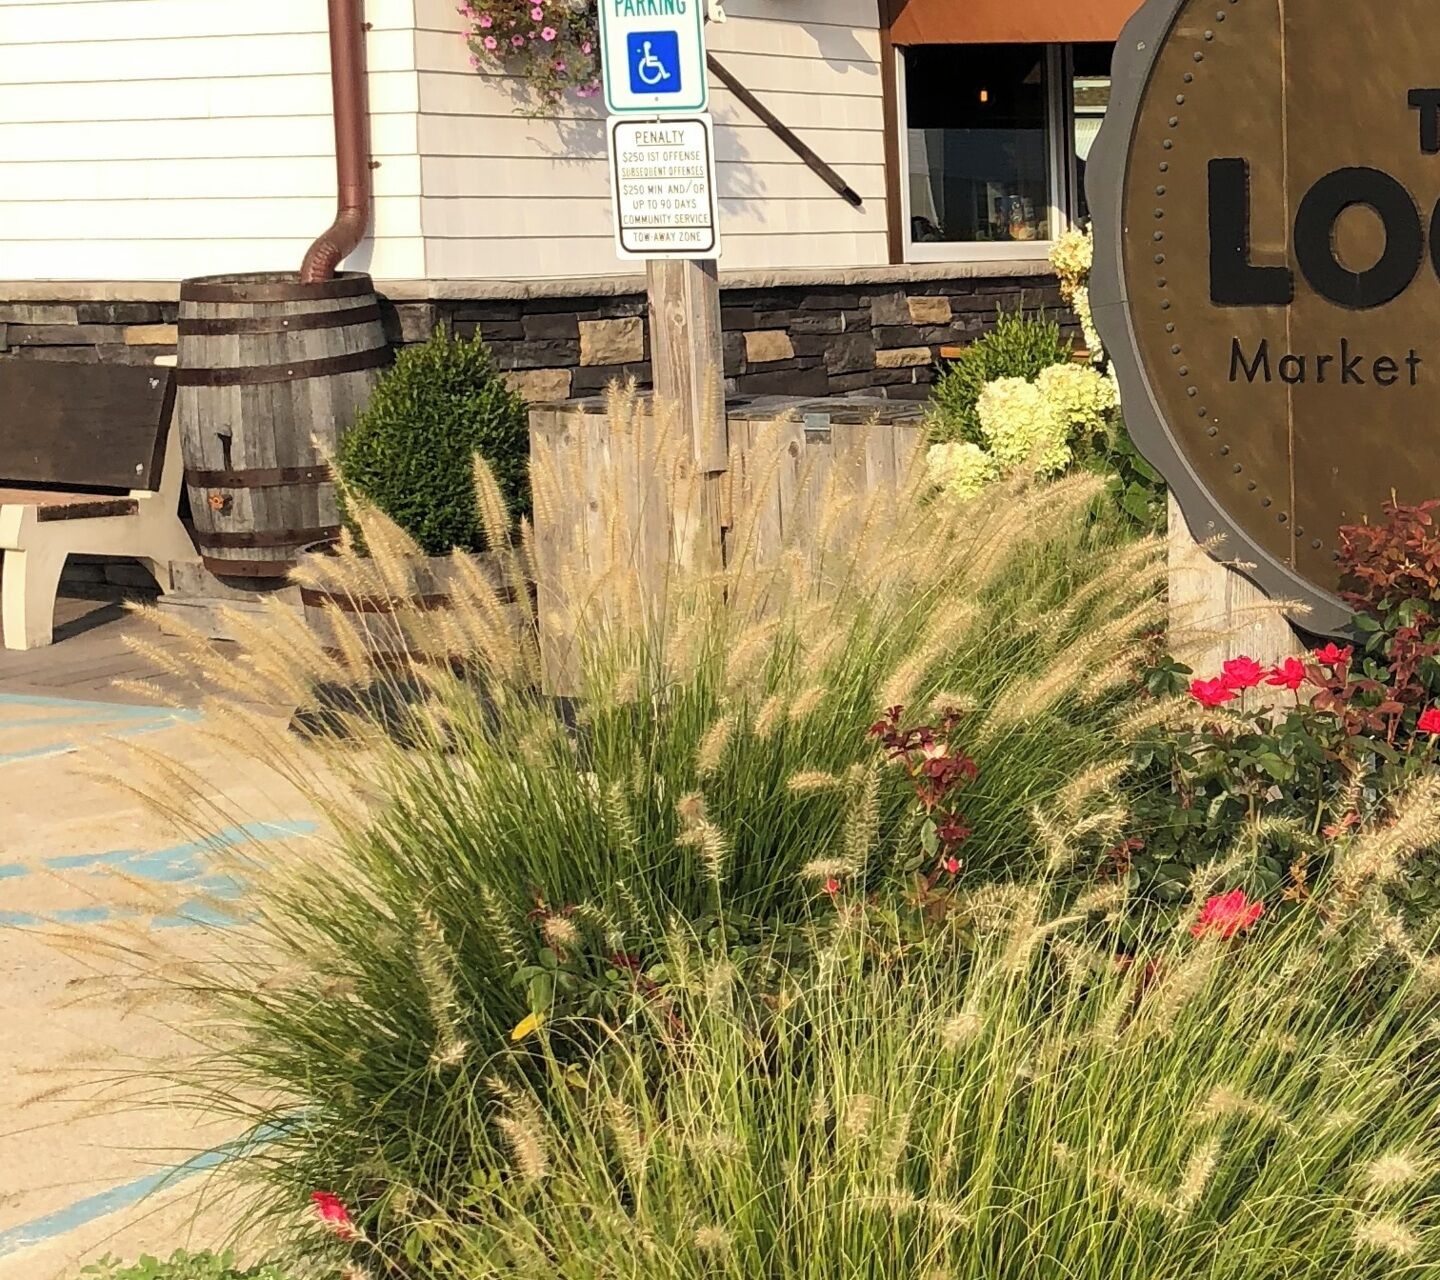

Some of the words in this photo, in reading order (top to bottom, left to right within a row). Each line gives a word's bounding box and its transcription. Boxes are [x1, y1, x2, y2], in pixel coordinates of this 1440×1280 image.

[635, 130, 685, 144] PENALTY
[622, 151, 645, 163] $250
[662, 150, 701, 161] OFFENSE
[621, 167, 667, 177] SUBSEQUENT
[669, 166, 704, 176] OFFENSES
[623, 185, 645, 195] $250
[647, 184, 663, 194] MIN
[667, 180, 705, 194] AND/OR
[632, 200, 645, 210] UP
[647, 200, 658, 210] TO
[660, 199, 672, 209] 90
[674, 198, 697, 209] DAYS
[623, 214, 672, 225] COMMUNITY
[674, 213, 709, 224] SERVICE
[633, 232, 676, 242] TOW-AWAY
[679, 231, 702, 241] ZONE
[1228, 336, 1421, 385] Market
